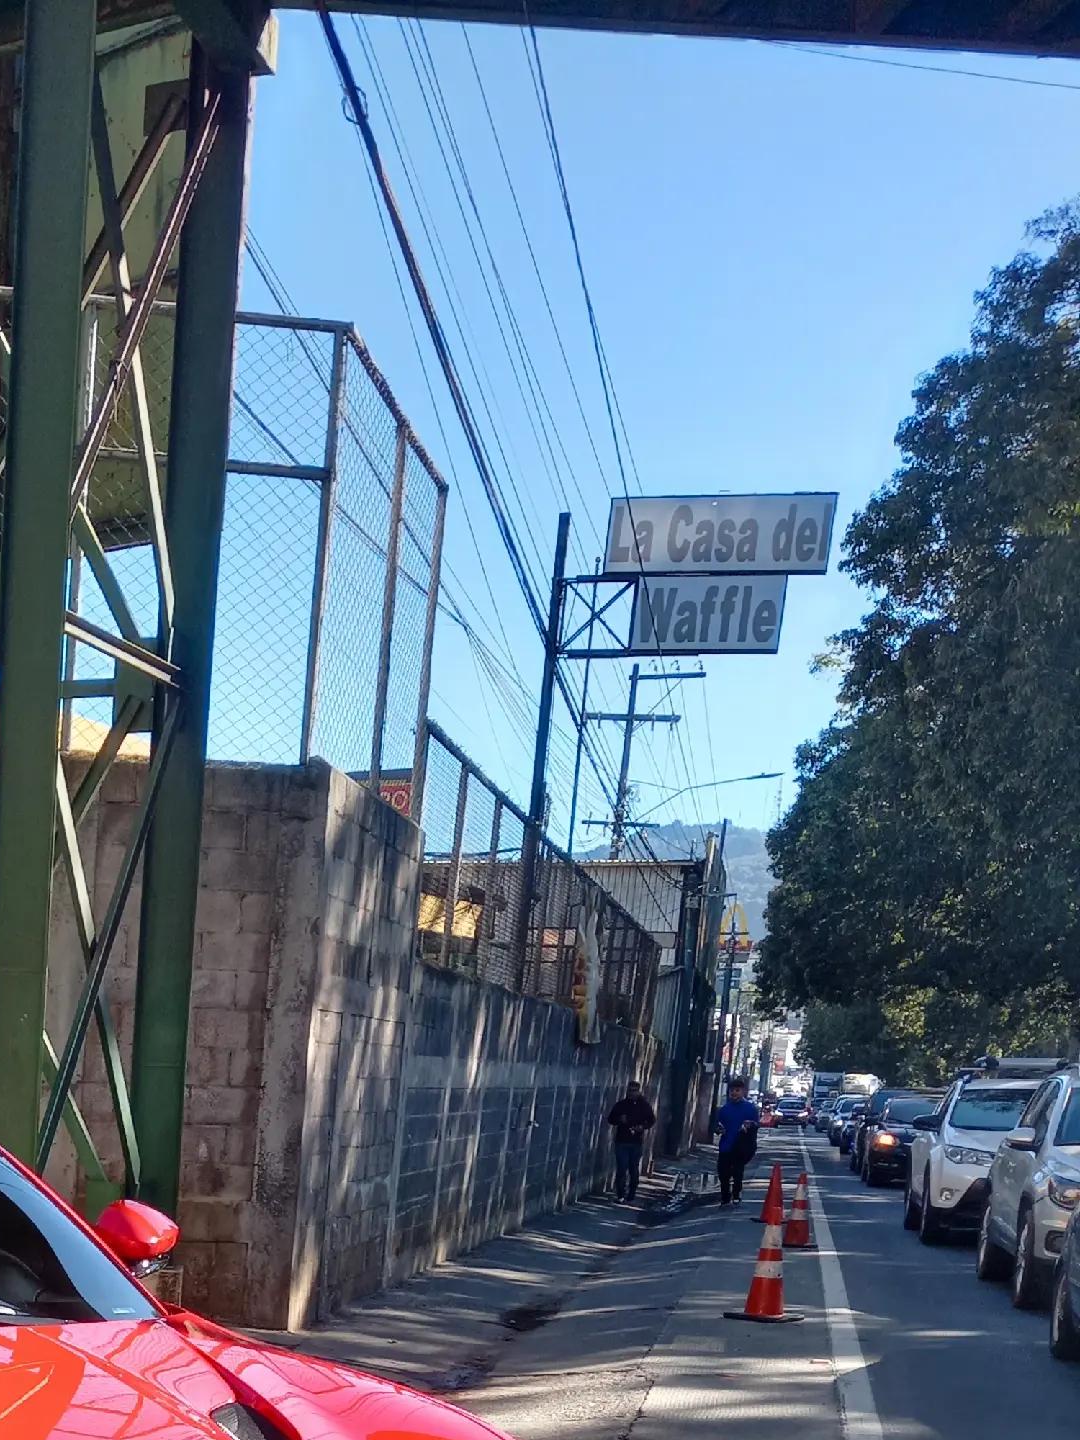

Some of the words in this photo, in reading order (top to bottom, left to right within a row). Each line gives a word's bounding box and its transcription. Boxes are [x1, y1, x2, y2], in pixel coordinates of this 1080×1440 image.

[608, 506, 654, 563] La
[667, 504, 760, 564] Casa
[772, 503, 833, 563] del
[639, 584, 777, 643] Waffle
